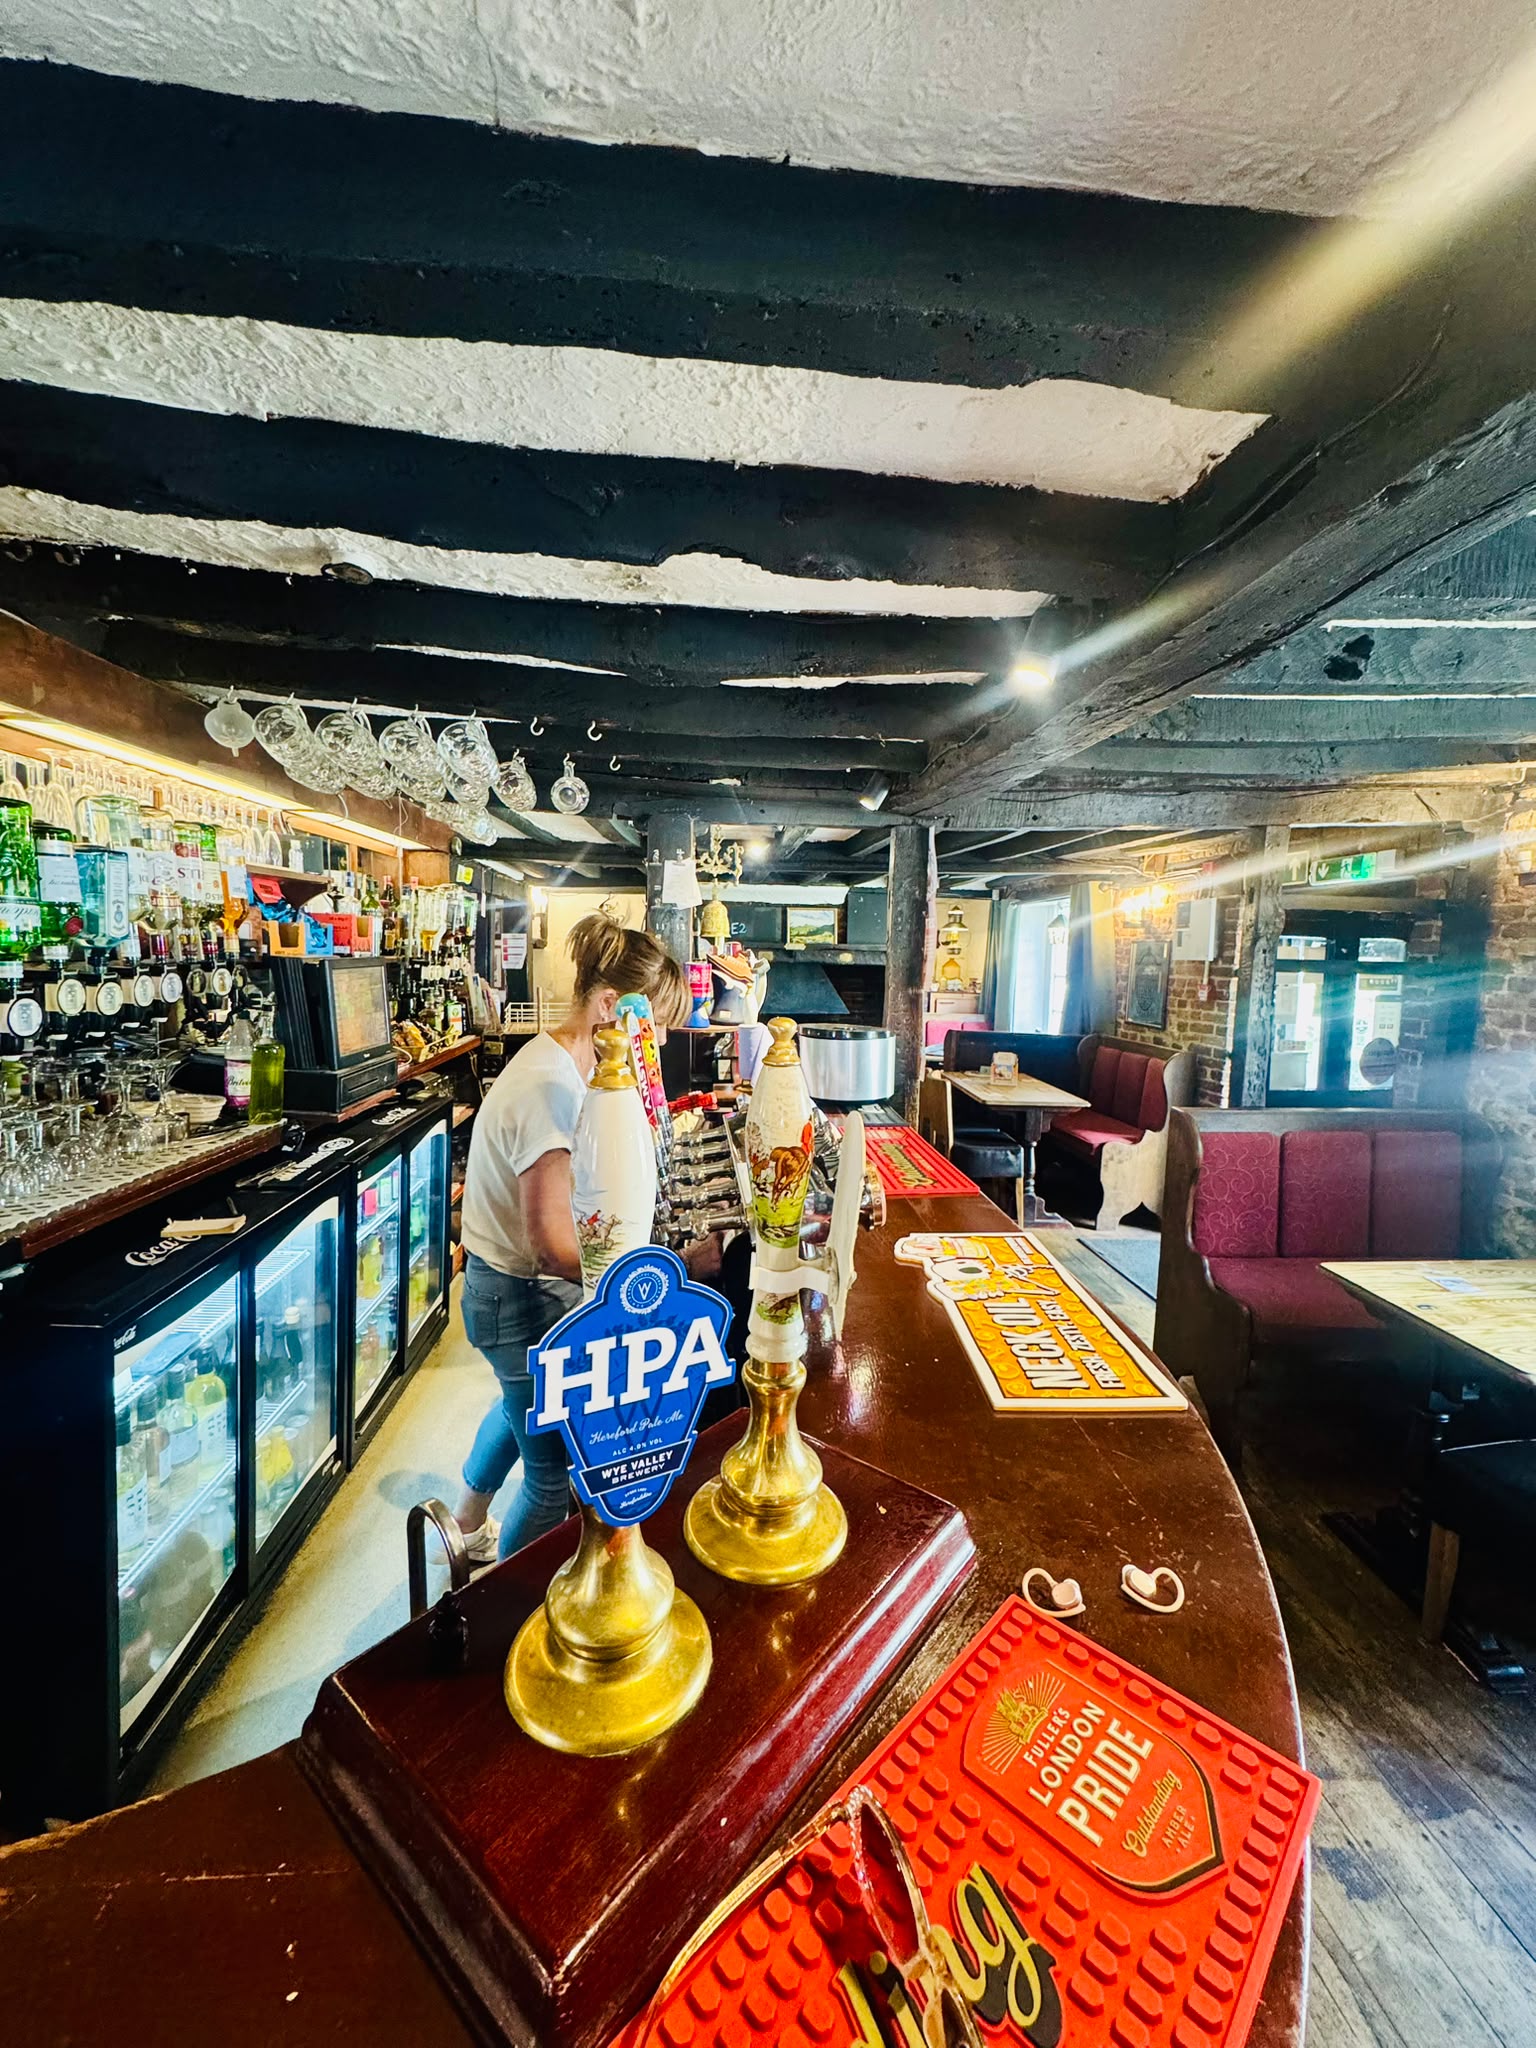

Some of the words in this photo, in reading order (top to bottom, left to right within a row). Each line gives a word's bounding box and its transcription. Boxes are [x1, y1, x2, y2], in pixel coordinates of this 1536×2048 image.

[983, 1297, 1043, 1327] OIL
[537, 1316, 733, 1427] HPA
[1000, 1329, 1090, 1389] NECK
[589, 1421, 638, 1445] Hereford
[639, 1415, 664, 1431] Pale
[665, 1409, 686, 1424] Ale
[612, 1447, 627, 1457] ALC
[649, 1437, 664, 1446] VOL
[601, 1464, 628, 1479] WYE
[631, 1450, 673, 1471] VALLEY
[611, 1462, 665, 1485] BREWERY
[1023, 1707, 1071, 1767] FULLER'S
[1027, 1700, 1106, 1807] LONDON
[1056, 1718, 1154, 1848] PRIDE
[1121, 1768, 1183, 1857] Outstanding
[1161, 1805, 1187, 1849] AMBER
